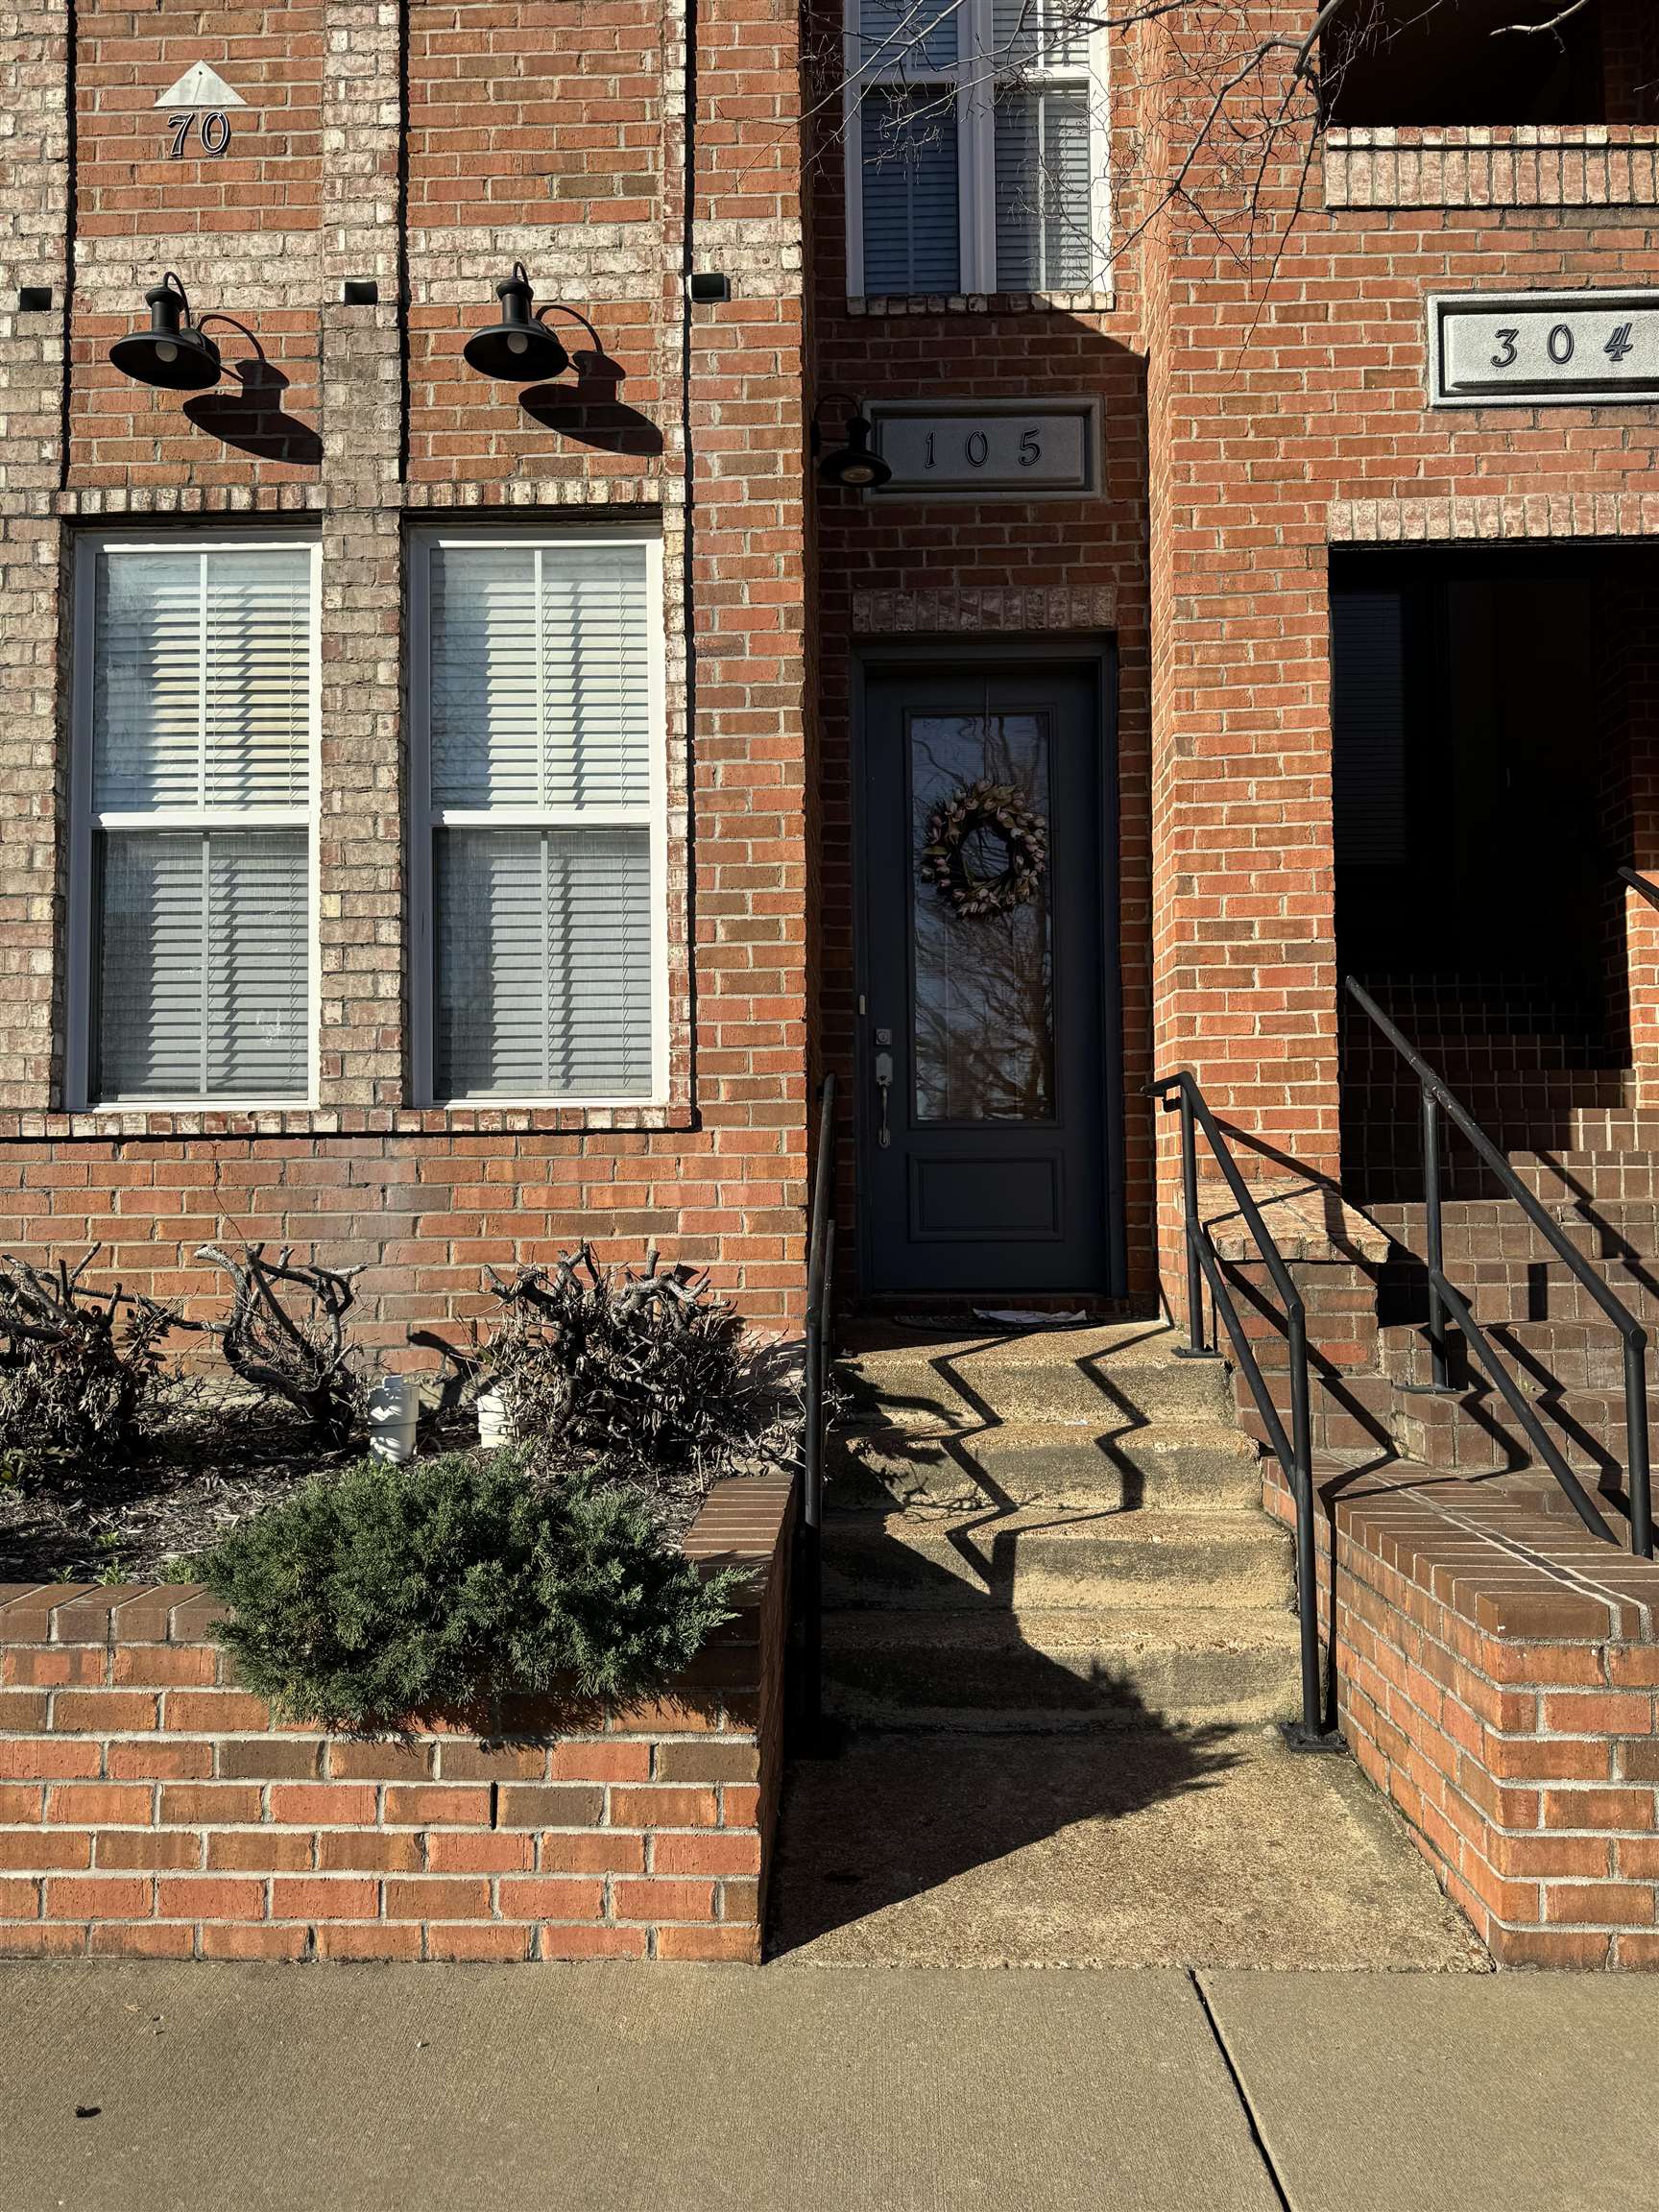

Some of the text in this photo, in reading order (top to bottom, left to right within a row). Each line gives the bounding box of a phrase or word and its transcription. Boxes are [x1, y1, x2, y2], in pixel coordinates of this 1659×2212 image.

[167, 111, 230, 157] 70
[1490, 322, 1633, 368] 304
[925, 429, 1042, 469] 105
